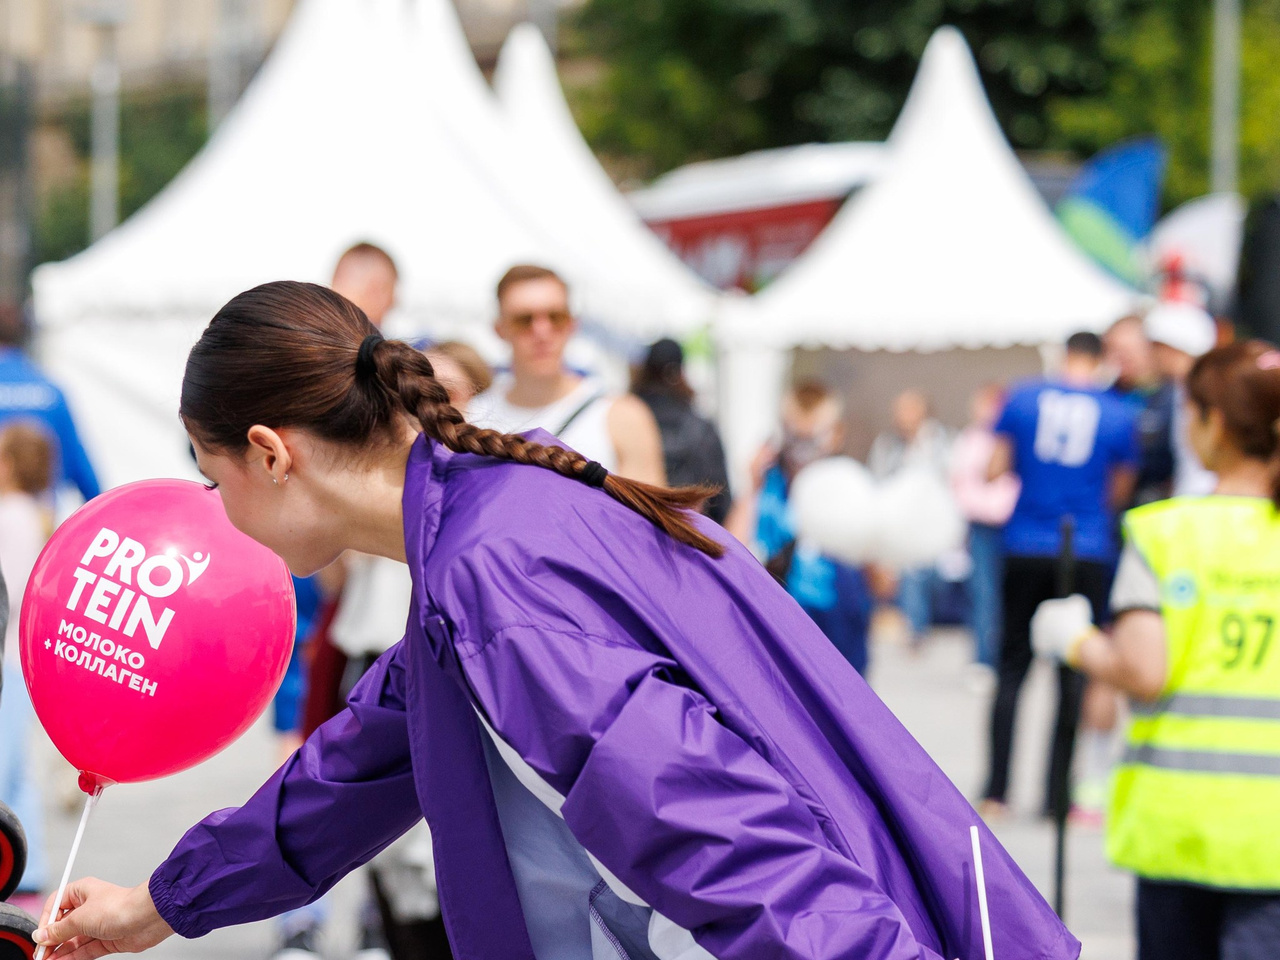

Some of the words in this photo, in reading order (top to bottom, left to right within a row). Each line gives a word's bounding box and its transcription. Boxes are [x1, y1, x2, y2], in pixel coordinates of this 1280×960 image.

[80, 527, 184, 598] PRO
[66, 567, 175, 650] TEIN
[54, 640, 158, 696] КОЛЛАГЕН
[58, 619, 145, 669] МОЛОКО
[1221, 612, 1275, 670] 97
